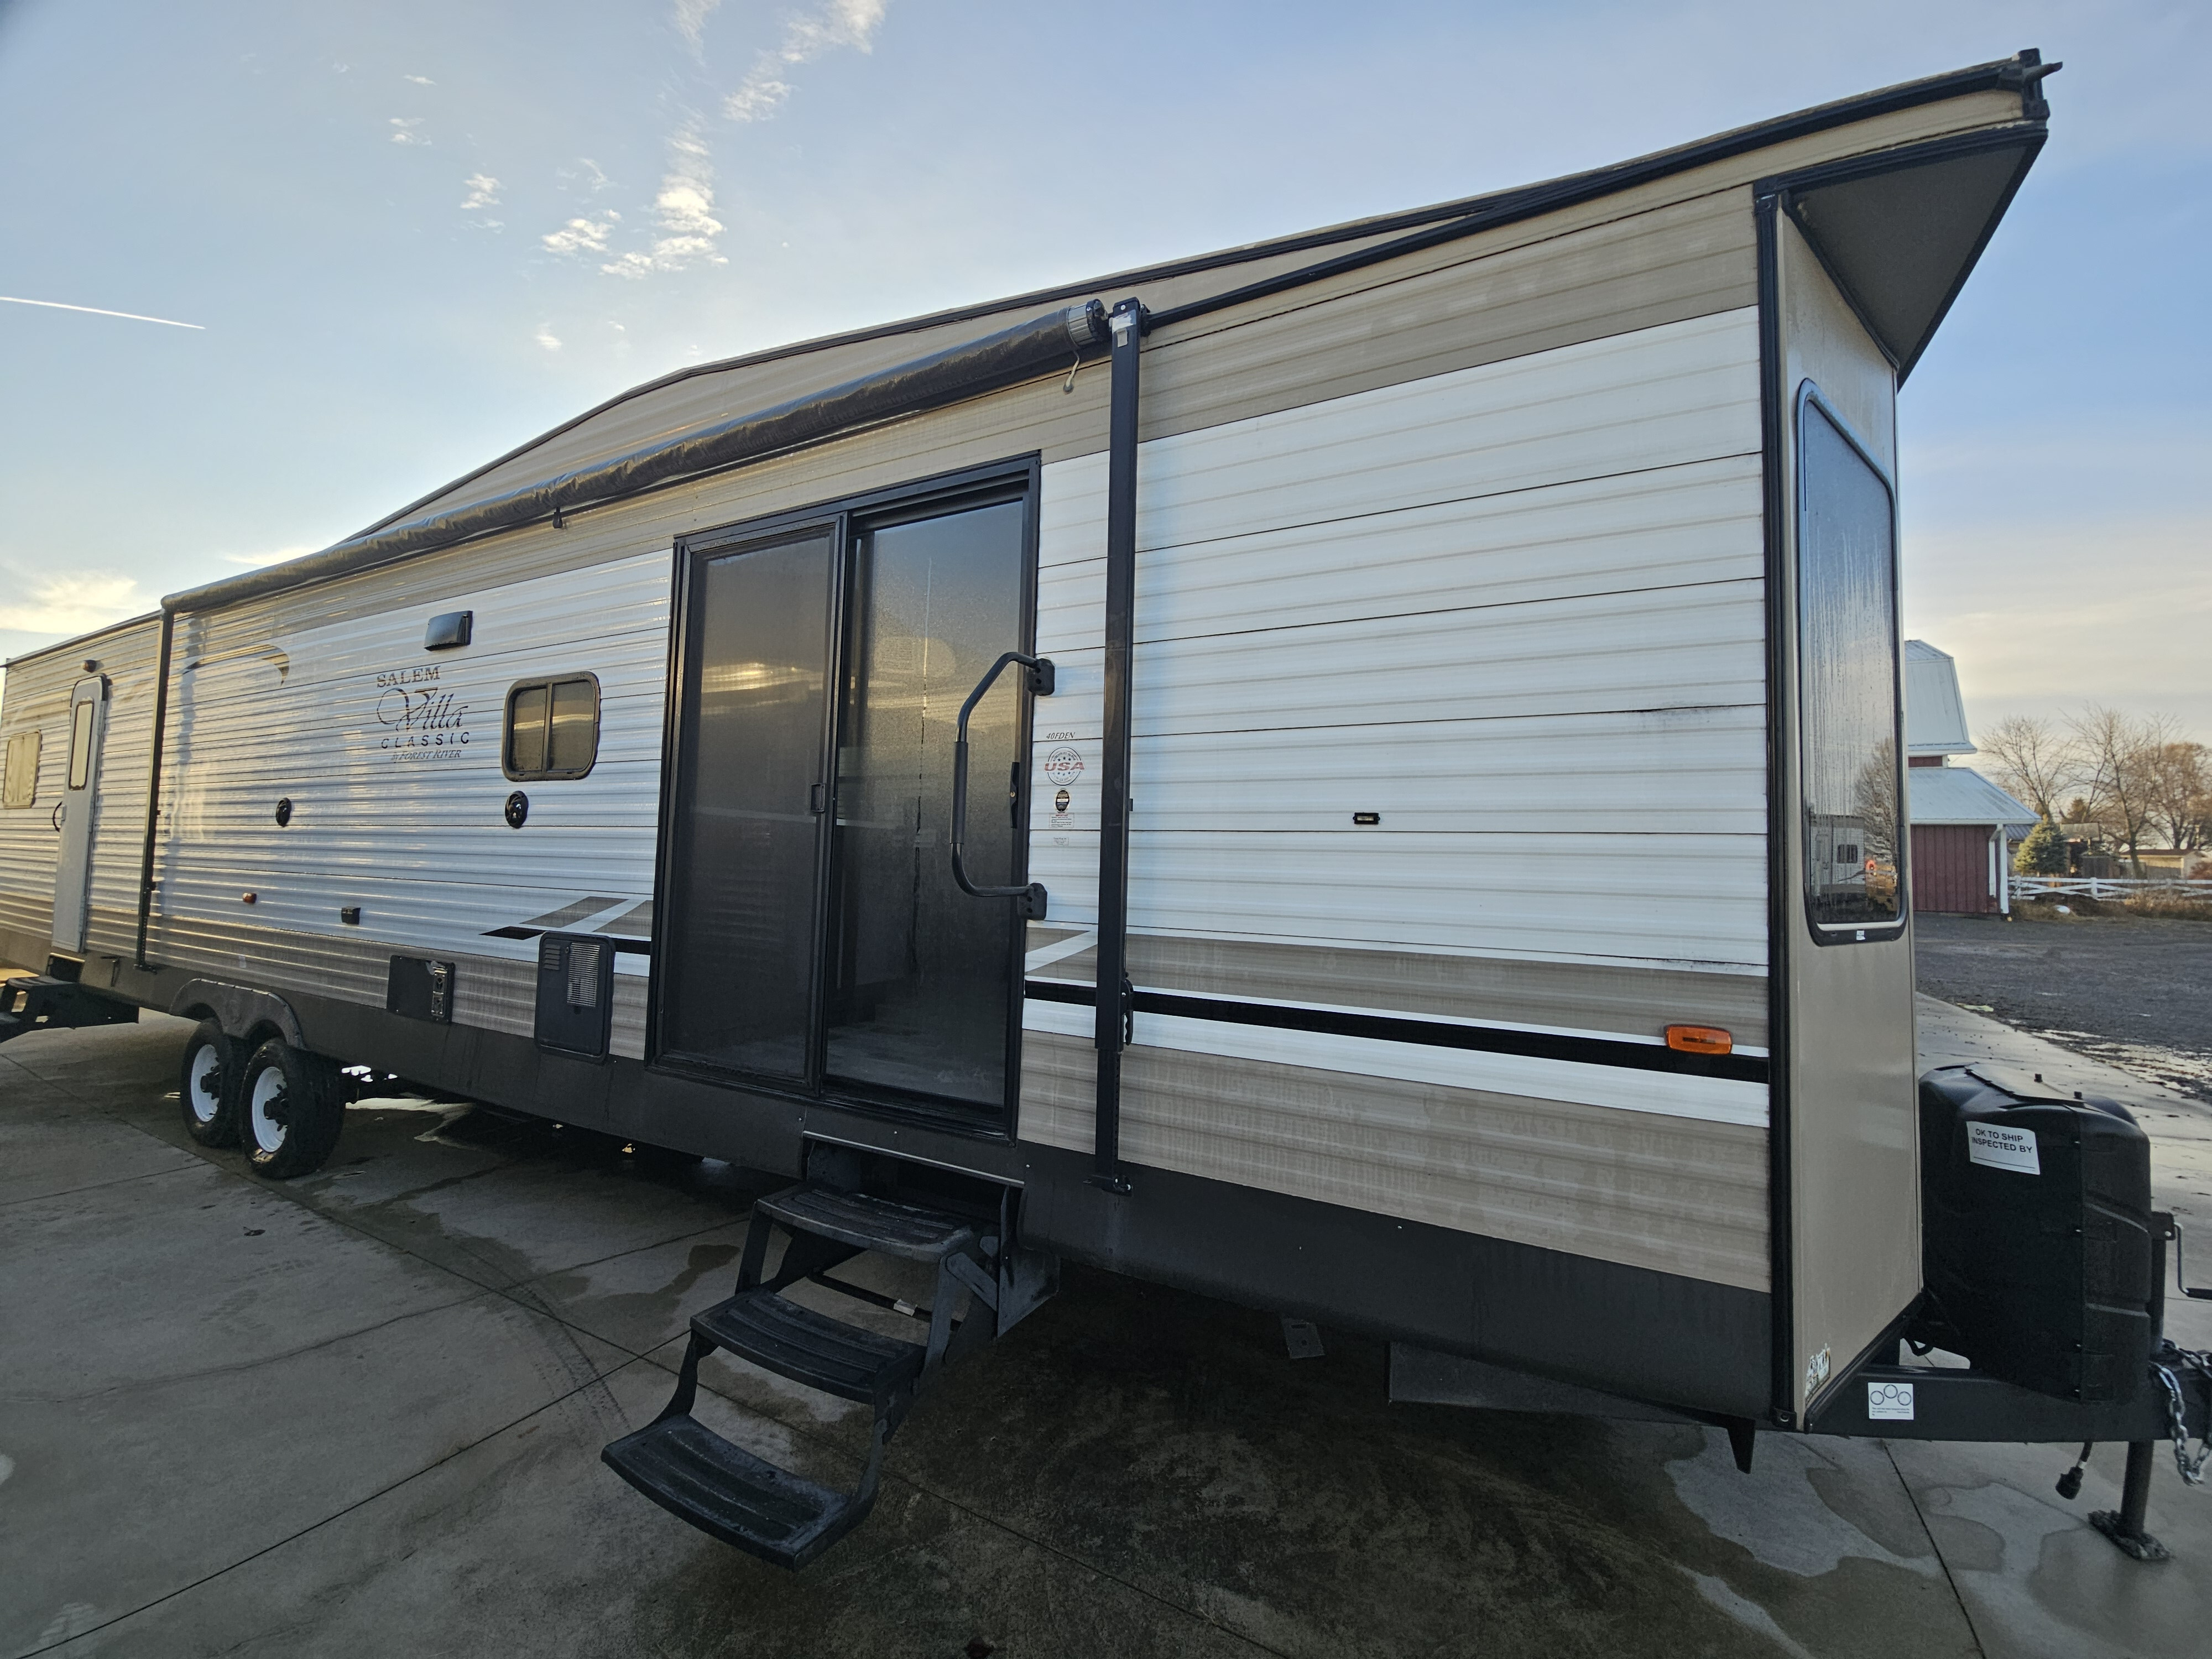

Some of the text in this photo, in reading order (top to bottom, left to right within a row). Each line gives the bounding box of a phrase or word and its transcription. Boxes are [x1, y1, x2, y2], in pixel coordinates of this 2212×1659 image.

[377, 665, 441, 688] SALEM
[377, 687, 468, 732] Villa
[381, 732, 469, 749] CLASSIC
[399, 751, 433, 760] FOREST
[433, 749, 461, 758] RIVER
[1044, 761, 1085, 771] USA
[1975, 1128, 2023, 1142] OK TO SHIP
[1971, 1137, 2032, 1153] INSPECTED BY
